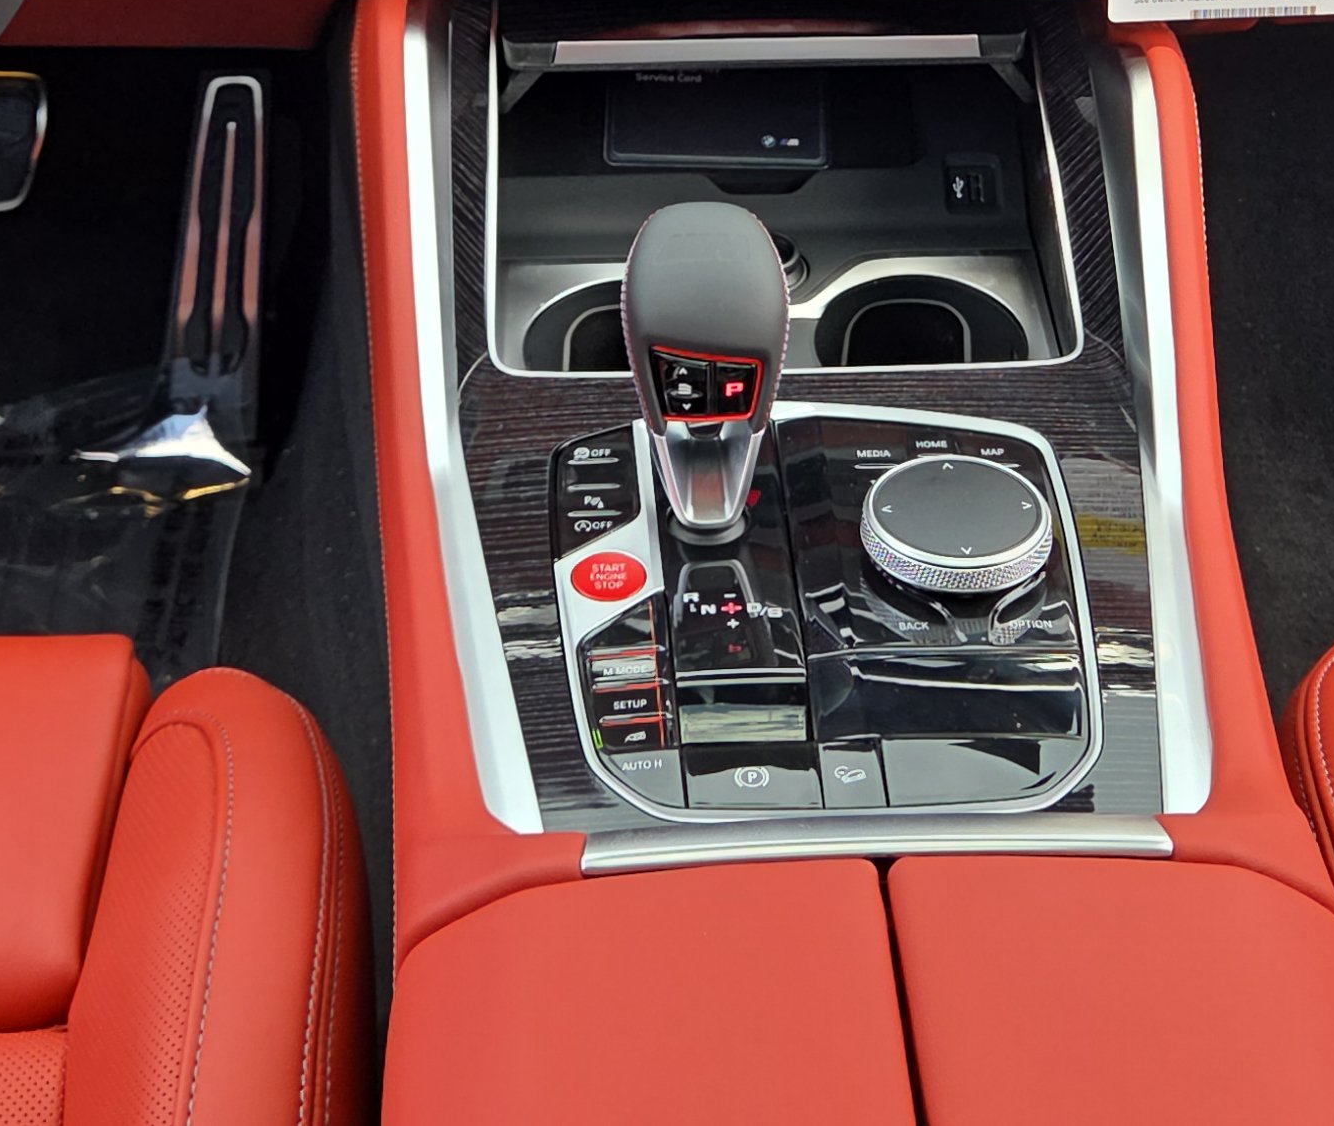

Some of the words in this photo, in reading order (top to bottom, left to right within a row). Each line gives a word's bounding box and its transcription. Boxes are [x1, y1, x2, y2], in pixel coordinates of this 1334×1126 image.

[635, 71, 674, 82] Service
[677, 72, 702, 83] Card
[725, 381, 744, 397] P
[915, 440, 948, 449] HOME
[591, 448, 611, 457] OFF
[856, 449, 891, 458] MEDIA
[980, 448, 1005, 456] MAP
[592, 521, 613, 530] OFF
[591, 562, 627, 573] START
[589, 573, 627, 582] ENGINE
[594, 580, 624, 590] STOP
[683, 592, 700, 603] R
[701, 604, 717, 615] N
[898, 621, 930, 631] BACK
[1009, 619, 1054, 630] OPTION
[613, 699, 647, 710] SETUP
[622, 761, 651, 771] AUTO
[654, 759, 663, 769] H
[748, 771, 758, 783] P
